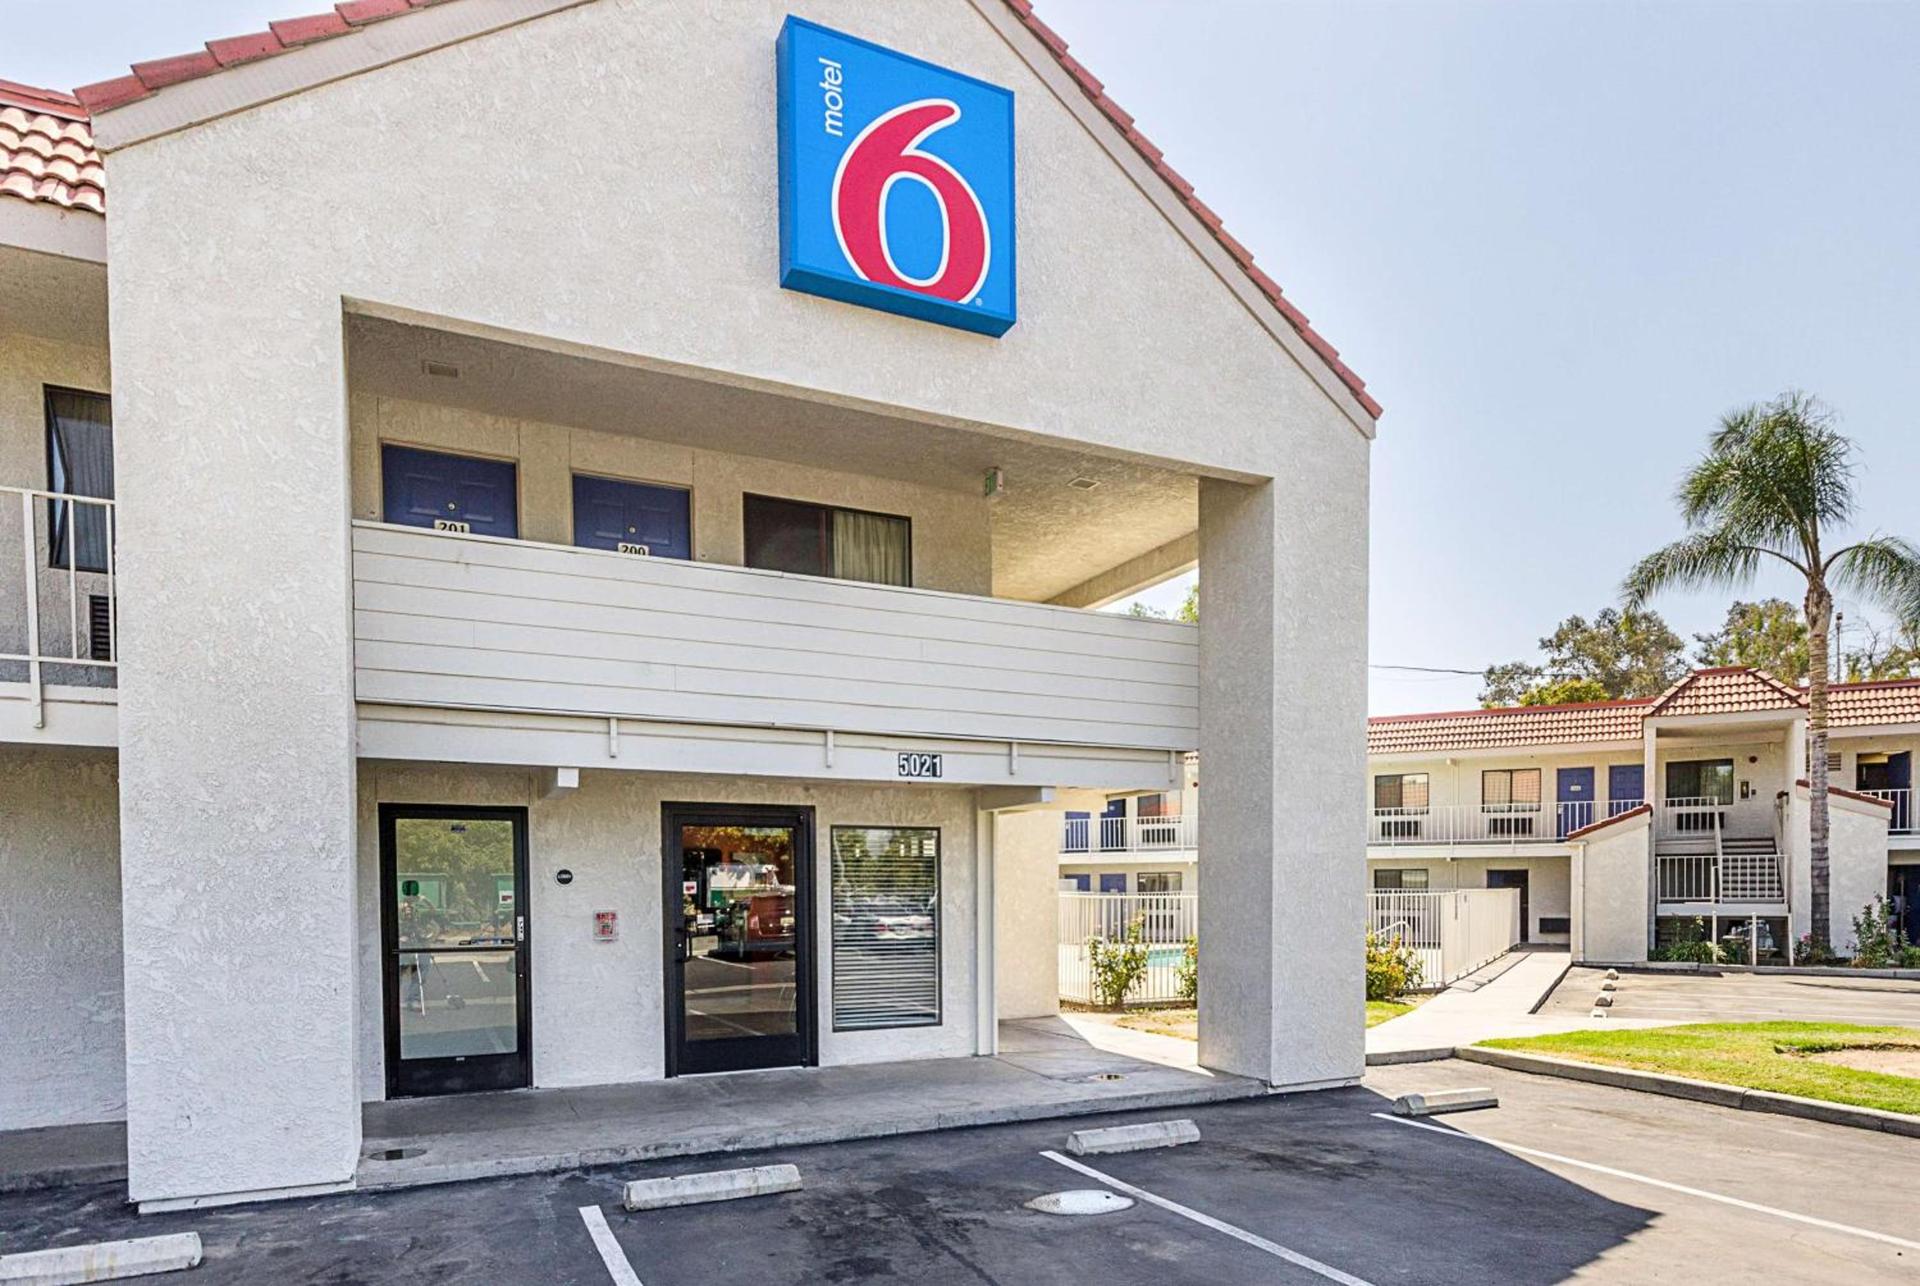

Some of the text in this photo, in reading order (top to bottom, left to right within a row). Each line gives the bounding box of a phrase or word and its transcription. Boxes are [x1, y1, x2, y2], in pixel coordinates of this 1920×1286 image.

[818, 57, 843, 136] motel
[832, 98, 991, 304] 6
[899, 754, 941, 777] 5021
